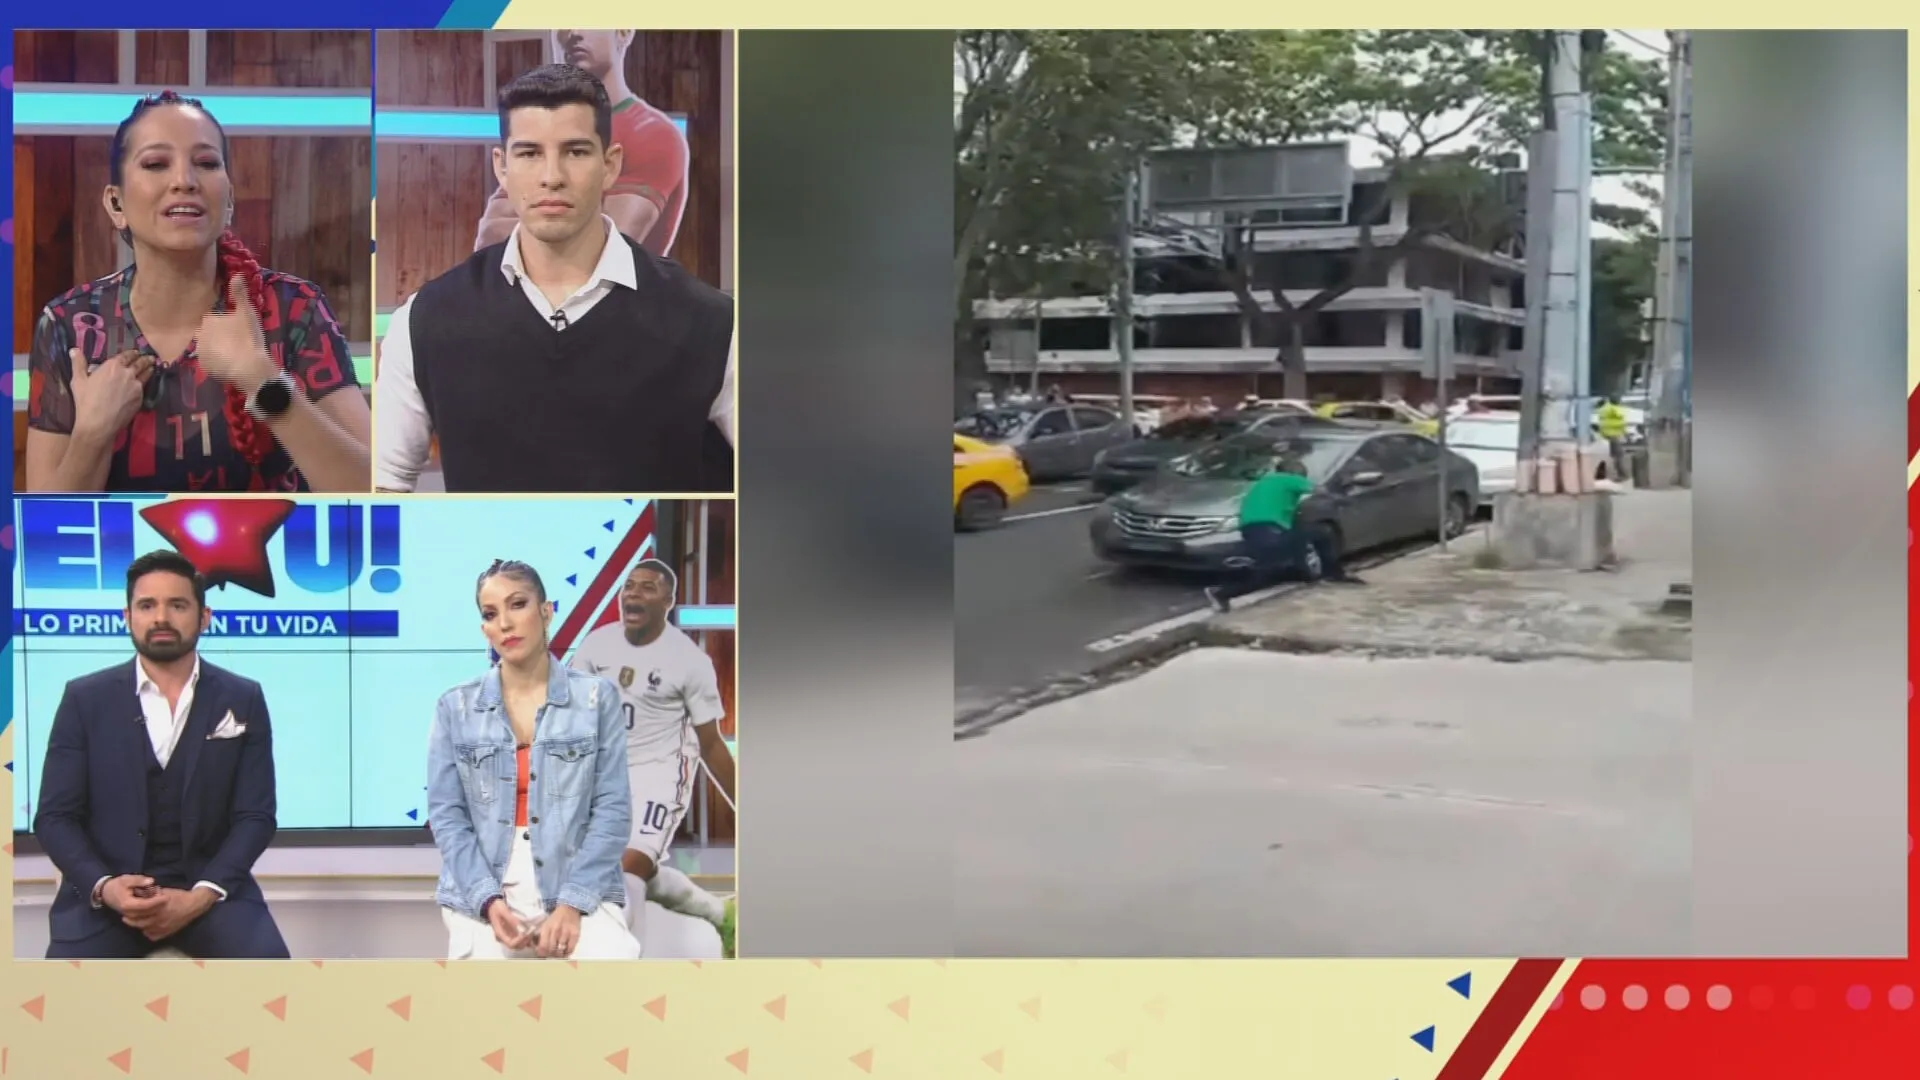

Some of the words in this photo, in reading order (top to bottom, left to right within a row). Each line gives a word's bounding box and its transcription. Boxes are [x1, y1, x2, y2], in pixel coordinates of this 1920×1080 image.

[24, 614, 60, 634] LO
[68, 614, 130, 634] PRIM
[235, 615, 269, 635] TU
[275, 614, 338, 635] VIDA
[643, 801, 668, 831] 10
